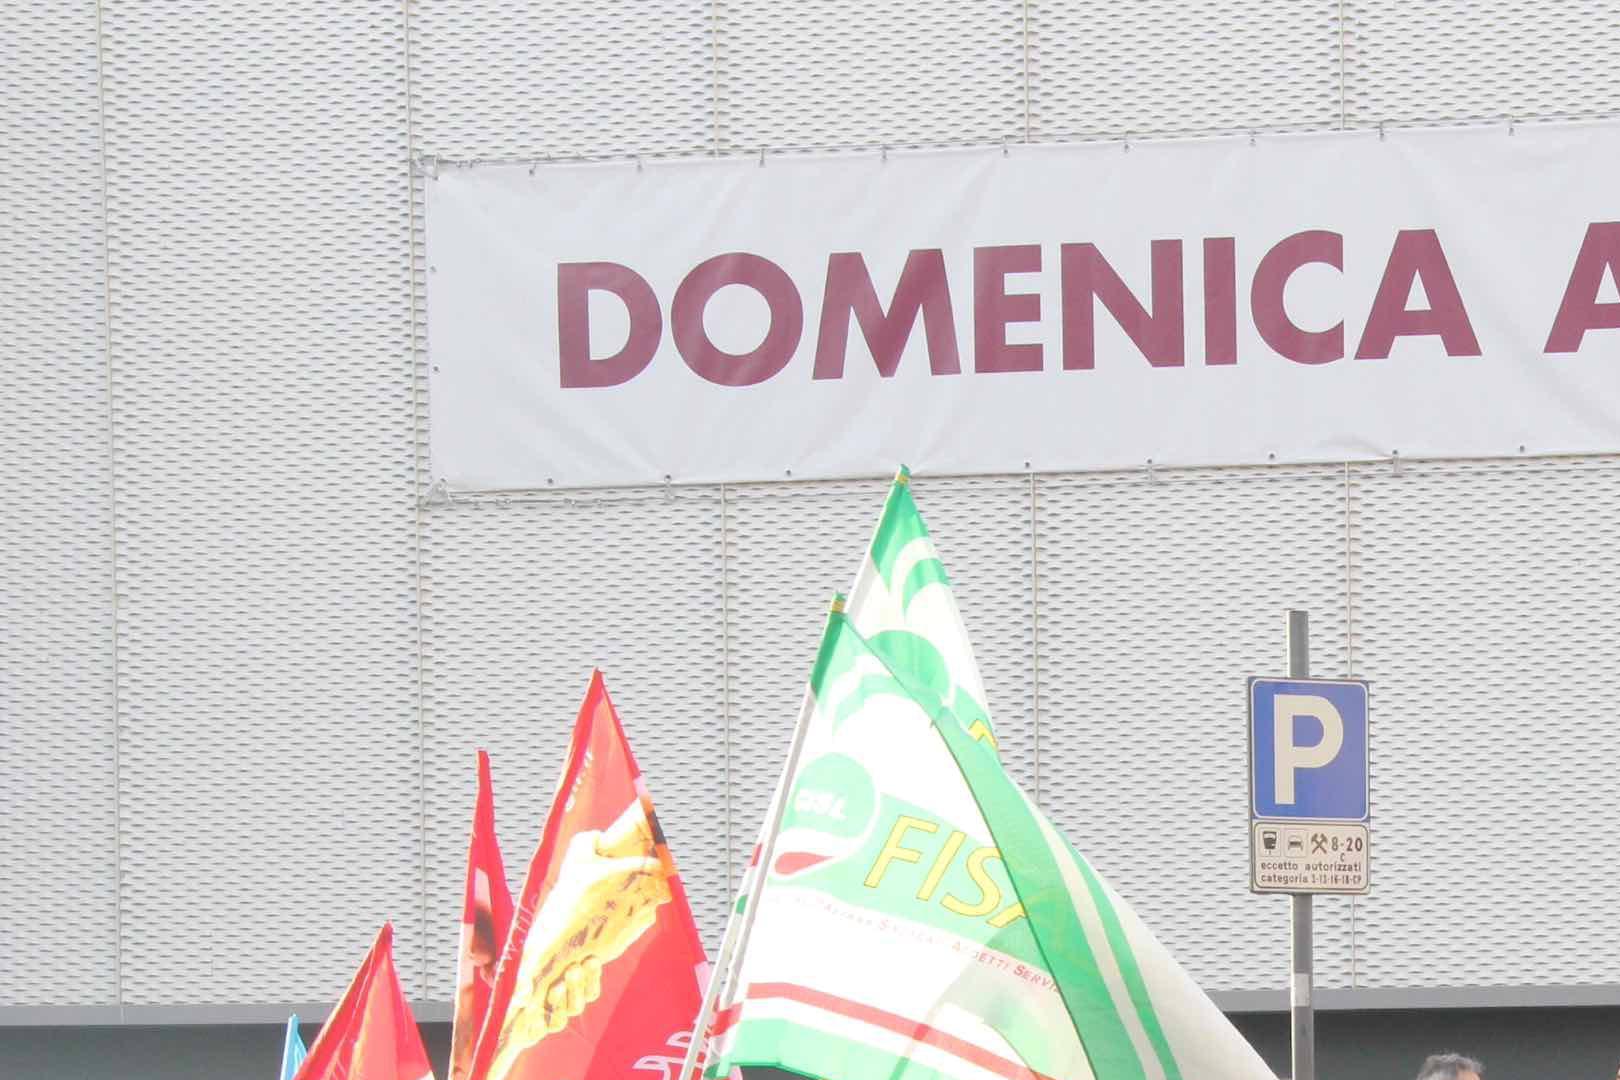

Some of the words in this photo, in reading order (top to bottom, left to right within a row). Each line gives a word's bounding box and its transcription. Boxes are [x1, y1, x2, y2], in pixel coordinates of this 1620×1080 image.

[558, 229, 1482, 389] DOMENICA
[1273, 693, 1344, 805] P
[1331, 836, 1363, 852] 8-20
[1261, 861, 1299, 872] eccetto
[1305, 861, 1361, 873] autorizzati
[1261, 873, 1309, 885] categoria
